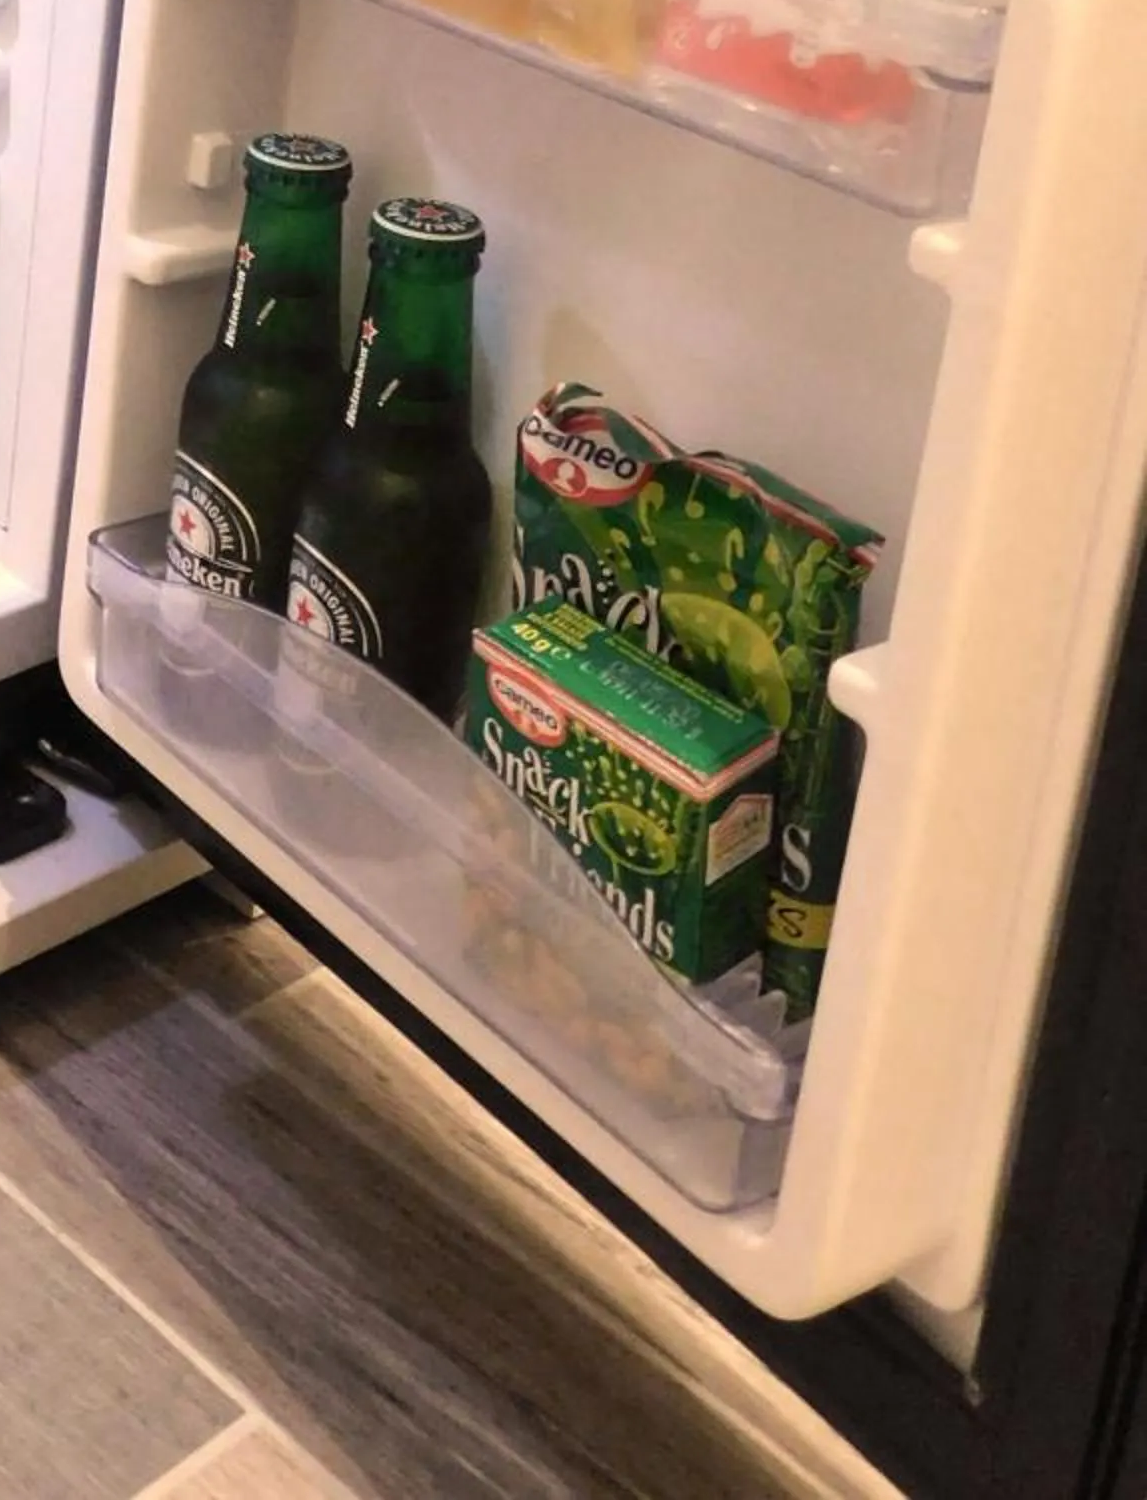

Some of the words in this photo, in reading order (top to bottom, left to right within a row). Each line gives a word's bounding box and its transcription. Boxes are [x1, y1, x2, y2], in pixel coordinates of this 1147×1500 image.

[224, 268, 246, 348] Heineken
[345, 342, 369, 428] Heineken
[191, 486, 236, 551] ORIGINAL
[309, 573, 356, 644] ORIGINAL
[494, 678, 559, 731] cameo
[482, 716, 592, 846] Snack
